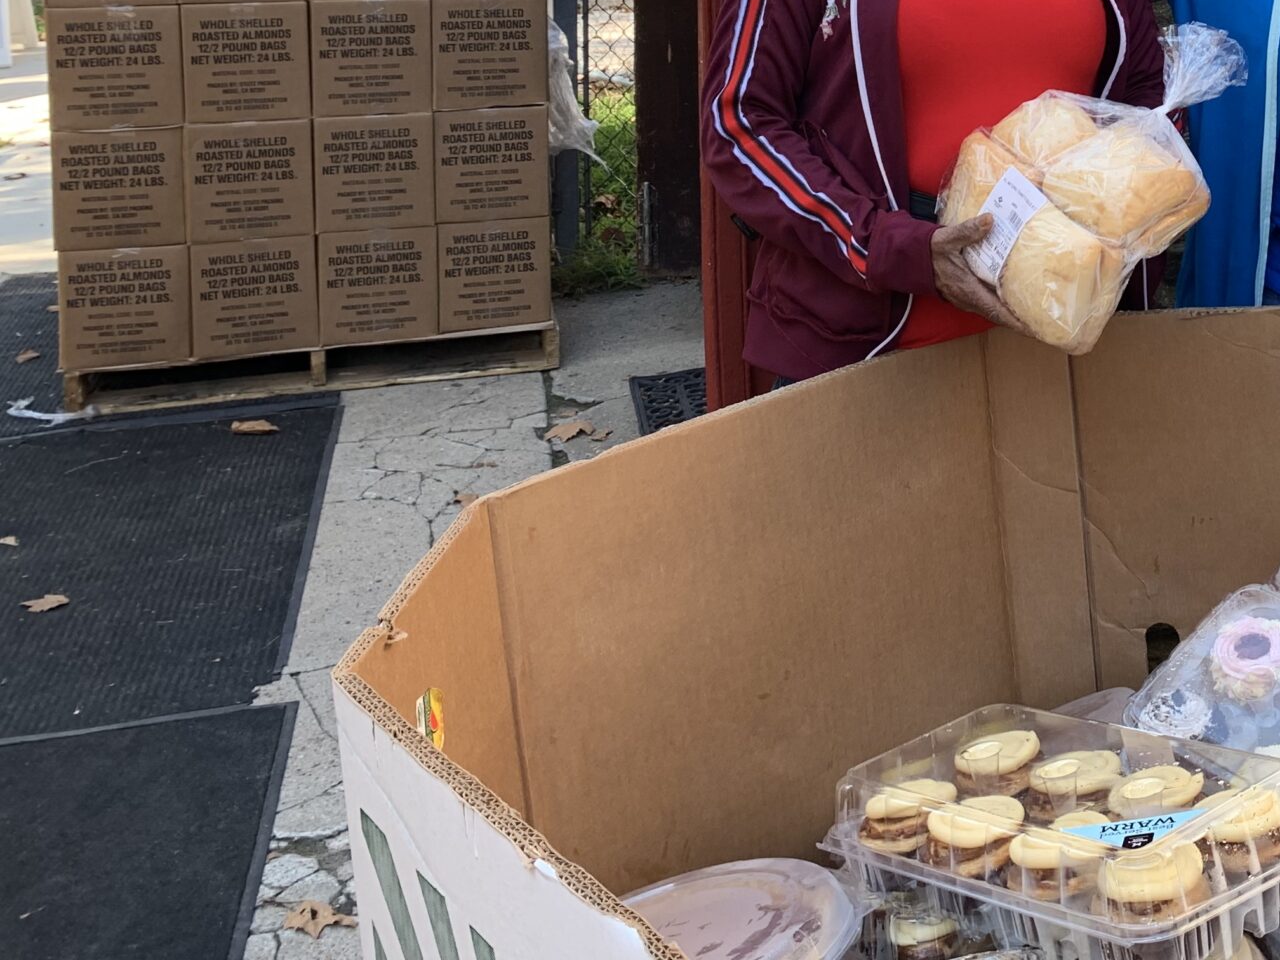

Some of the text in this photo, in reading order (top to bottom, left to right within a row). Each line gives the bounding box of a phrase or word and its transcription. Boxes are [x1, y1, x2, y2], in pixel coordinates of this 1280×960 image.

[447, 8, 524, 19] WHOLE SHELLED
[199, 18, 283, 30] WHOLE SHELLED
[321, 24, 416, 36] ROASTED ALMONDS
[440, 19, 532, 31] ROASTED ALMONDS
[192, 29, 292, 42] ROASTED ALMONDS
[326, 36, 411, 47] 12/2 POUND BAGS
[445, 30, 527, 42] 12/2 POUND BAGS
[198, 41, 287, 53] 12/2 POUND BAGS
[319, 47, 418, 59] NET WEIGHT: 24 LBS.
[439, 41, 534, 53] NET WEIGHT: 24 LBS.
[191, 52, 295, 65] NET WEIGHT: 24 LBS.
[449, 120, 526, 132] WHOLE SHELLED
[330, 128, 410, 141] WHOLE SHELLED
[443, 130, 533, 144] ROASTED ALMONDS
[68, 141, 157, 155] WHOLE SHELLED
[203, 136, 287, 149] WHOLE SHELLED
[323, 138, 418, 153] ROASTED ALMONDS
[447, 142, 529, 155] 12/2 POUND BAGS
[61, 153, 166, 167] ROASTED ALMONDS
[196, 147, 295, 162] ROASTED ALMONDS
[329, 150, 413, 164] 12/2 POUND BAGS
[441, 152, 536, 166] NET WEIGHT: 24 LBS.
[67, 165, 160, 179] 12/2 POUND BAGS
[201, 159, 290, 173] 12/2 POUND BAGS
[322, 161, 421, 175] NET WEIGHT: 24 LBS.
[60, 176, 168, 191] NET WEIGHT: 24 LBS.
[195, 170, 298, 185] NET WEIGHT: 24 LBS.
[453, 230, 528, 244] WHOLE SHELLED
[446, 240, 536, 256] ROASTED ALMONDS
[208, 250, 291, 266] WHOLE SHELLED
[328, 251, 422, 266] ROASTED ALMONDS
[451, 252, 531, 267] 12/2 POUND BAGS
[76, 258, 163, 273] WHOLE SHELLED
[201, 260, 300, 278] ROASTED ALMONDS
[333, 262, 417, 277] 12/2 POUND BAGS
[445, 262, 538, 278] NET WEIGHT: 24 LBS.
[68, 269, 172, 285] ROASTED ALMONDS
[206, 272, 295, 289] 12/2 POUND BAGS
[327, 273, 424, 289] NET WEIGHT: 24 LBS.
[74, 281, 166, 297] 12/2 POUND BAGS
[200, 283, 303, 301] NET WEIGHT: 24 LBS.
[67, 293, 174, 309] NET WEIGHT: 24 LBS.
[1100, 816, 1175, 833] WARM
